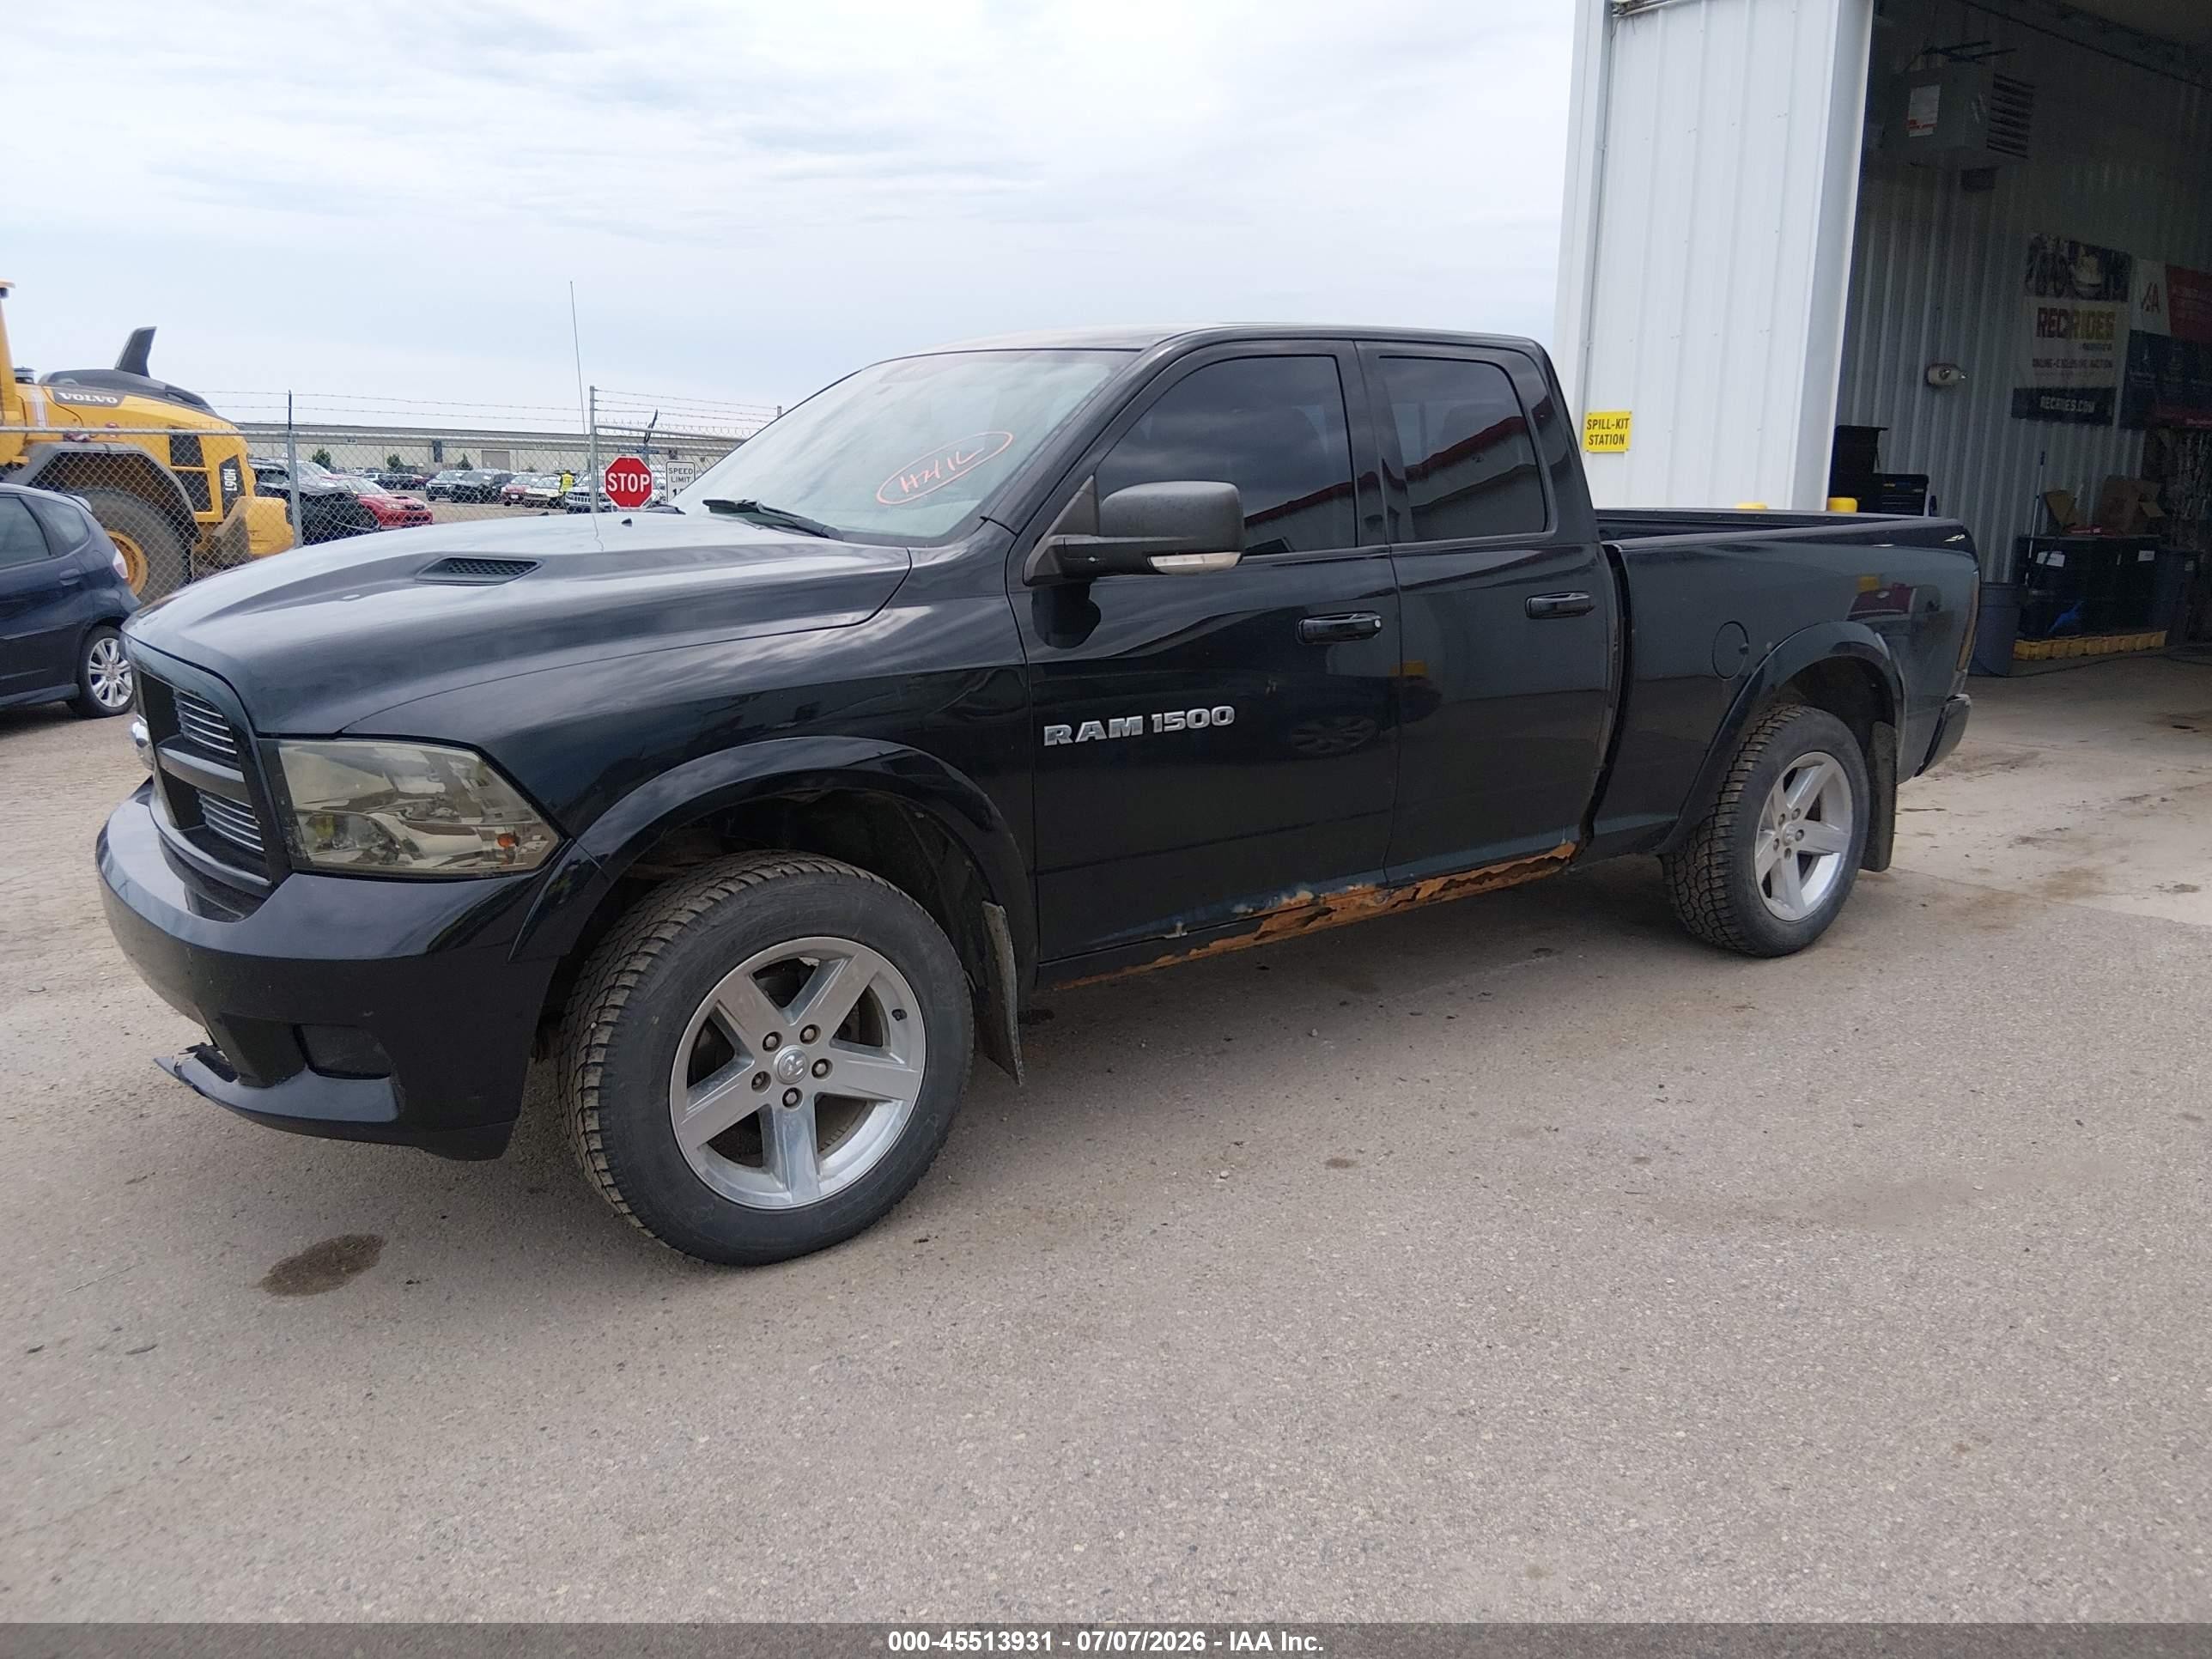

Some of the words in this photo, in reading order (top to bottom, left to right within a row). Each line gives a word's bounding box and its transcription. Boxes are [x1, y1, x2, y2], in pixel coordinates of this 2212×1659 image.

[58, 392, 118, 404] VOLVO
[1587, 418, 1630, 430] SPILL-KIT
[1589, 434, 1625, 446] STATION
[223, 468, 238, 491] L90H
[607, 472, 651, 494] STOP
[1043, 715, 1144, 746] RAM
[1151, 705, 1236, 734] 1500
